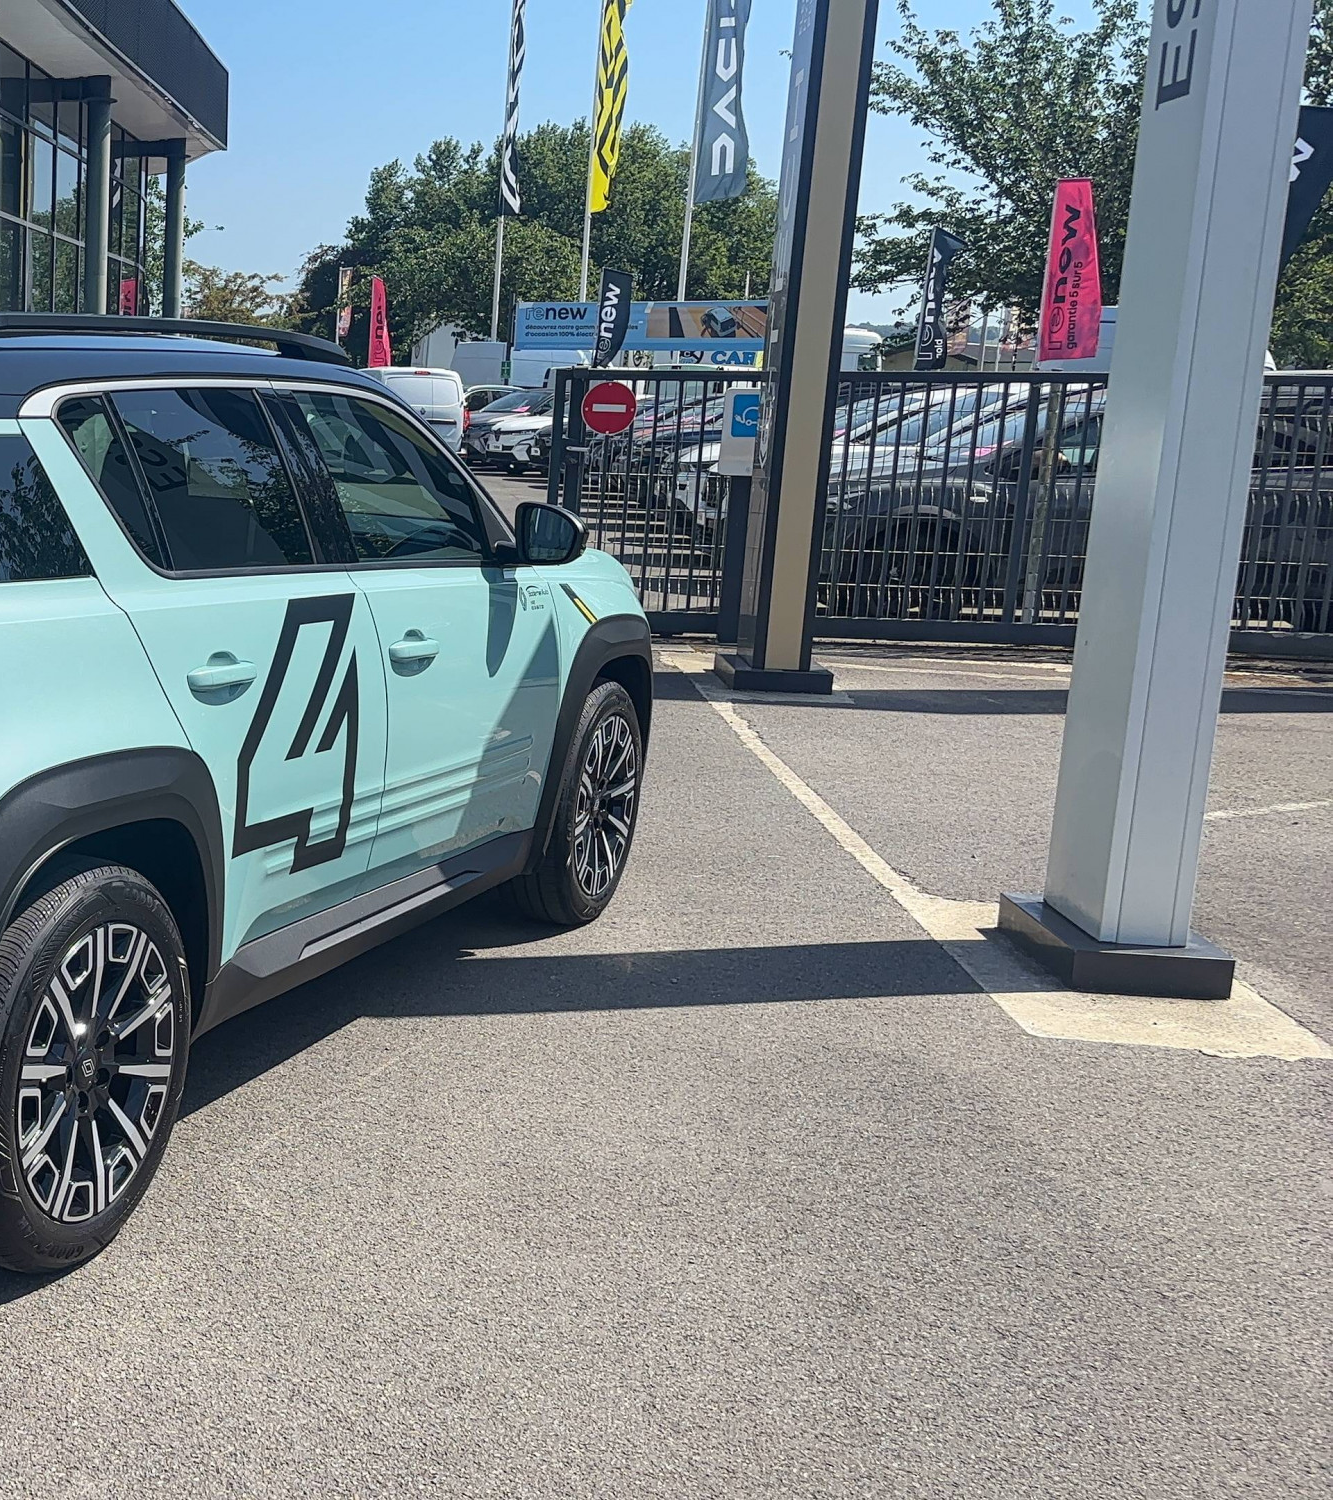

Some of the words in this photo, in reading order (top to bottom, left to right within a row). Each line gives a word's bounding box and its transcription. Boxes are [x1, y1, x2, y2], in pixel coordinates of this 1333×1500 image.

[711, 0, 736, 176] DACI
[1048, 203, 1082, 351] renew
[1072, 270, 1082, 289] sur
[1074, 261, 1083, 269] 5
[525, 306, 588, 320] renew
[1069, 290, 1078, 298] 5
[373, 305, 385, 363] rene
[596, 282, 621, 363] renew
[1067, 300, 1078, 349] garantie
[231, 593, 356, 875] 4
